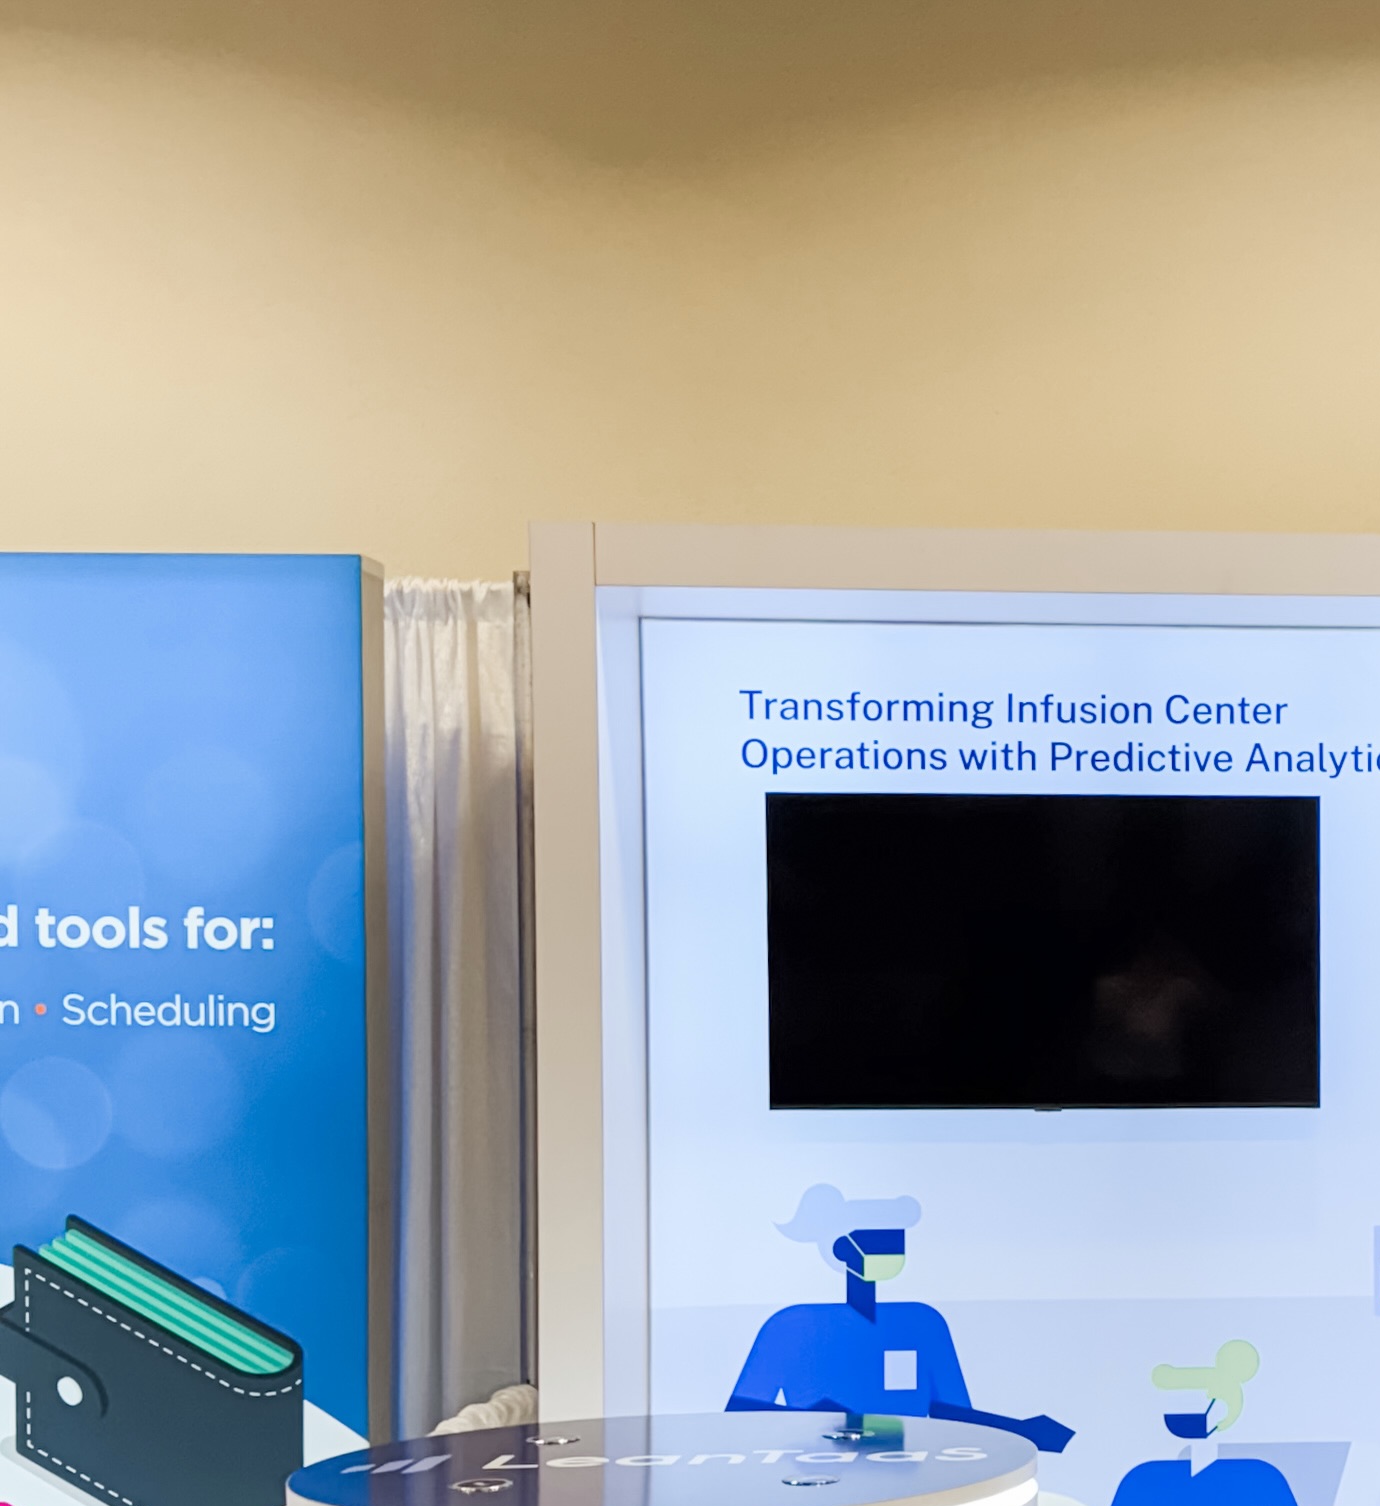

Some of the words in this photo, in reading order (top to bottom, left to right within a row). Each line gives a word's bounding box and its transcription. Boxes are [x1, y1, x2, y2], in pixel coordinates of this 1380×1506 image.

[739, 690, 994, 730] Transforming
[1007, 693, 1152, 725] Infusion
[1165, 694, 1288, 725] Center
[741, 738, 948, 775] Operations
[958, 740, 1037, 772] with
[1050, 741, 1233, 773] Predictive
[34, 905, 168, 949] tools
[183, 906, 275, 950] for:
[62, 993, 276, 1034] Scheduling
[481, 1446, 990, 1470] LeanTaaS
